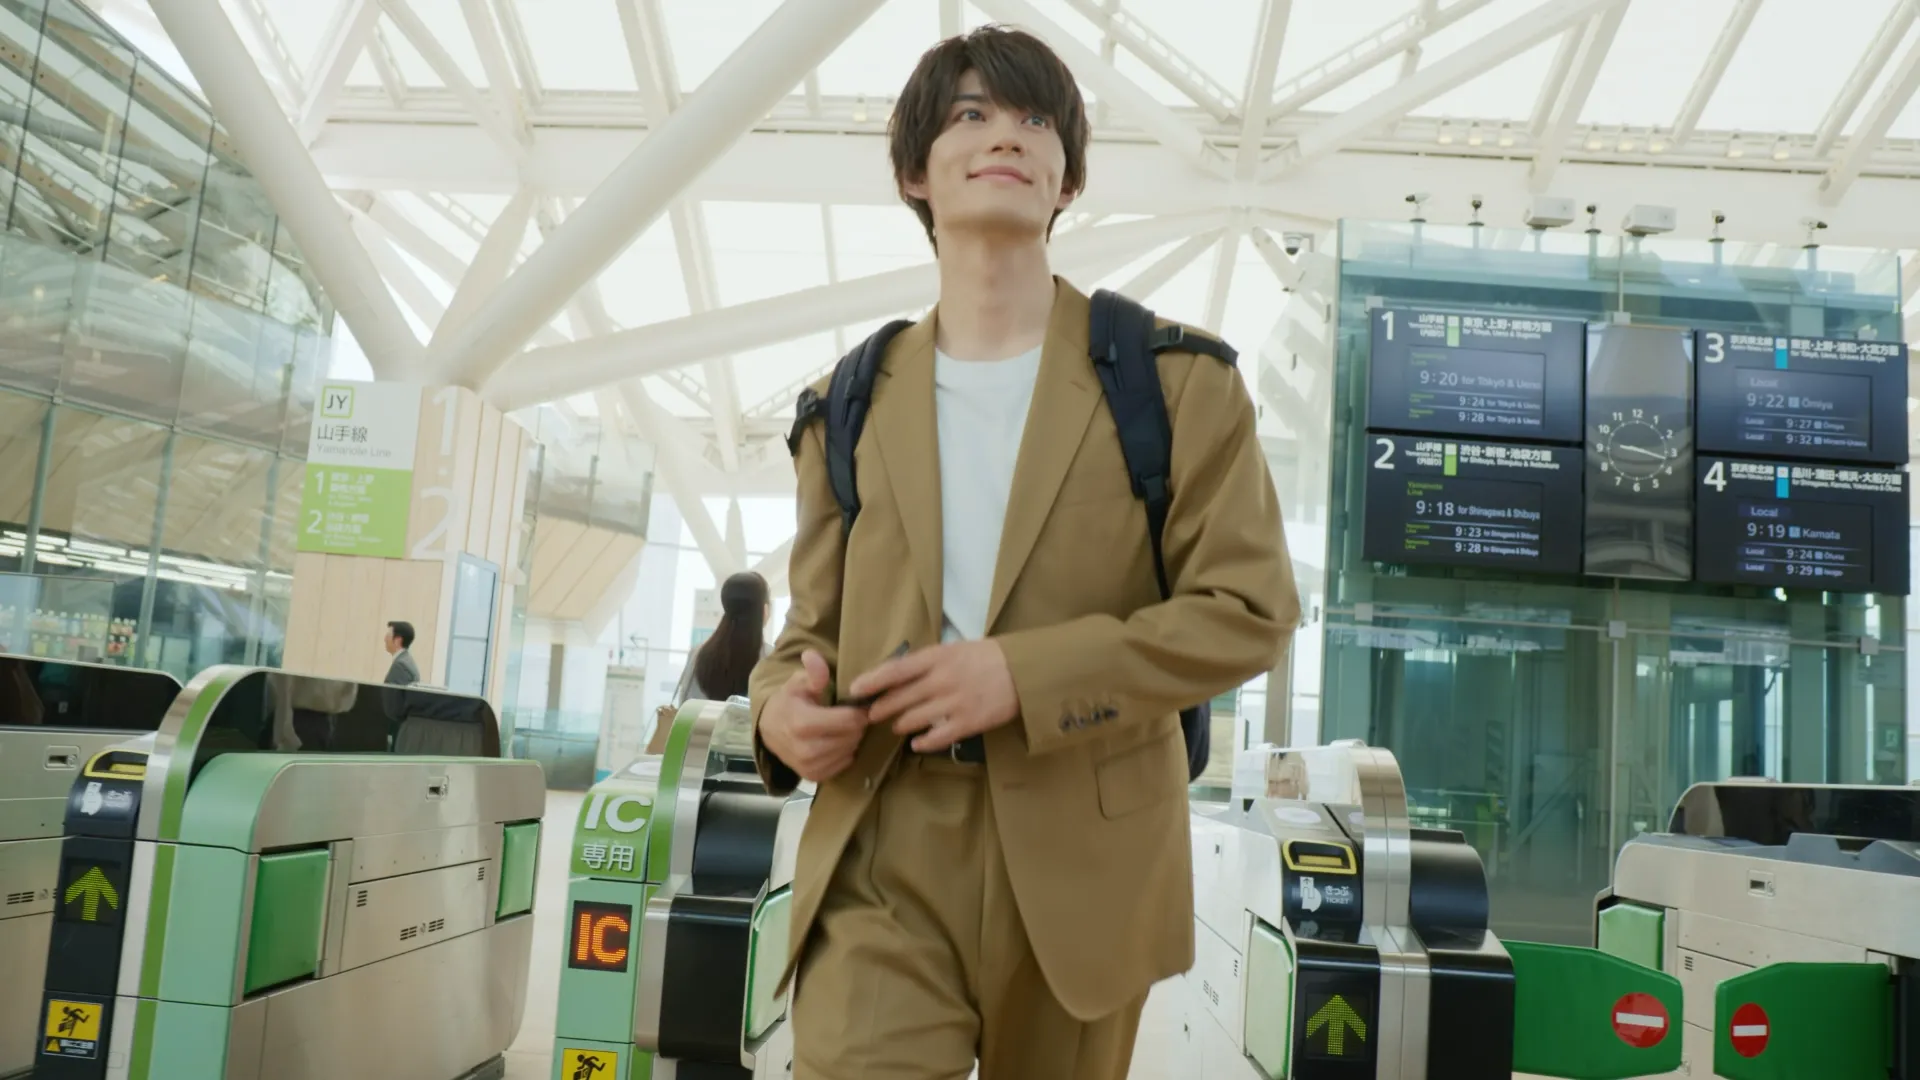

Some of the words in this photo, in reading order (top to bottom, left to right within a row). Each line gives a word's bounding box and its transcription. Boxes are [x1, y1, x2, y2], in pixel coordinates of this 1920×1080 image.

[1381, 311, 1394, 340] 1
[1704, 333, 1725, 363] 3
[1419, 370, 1458, 387] 9:20
[325, 394, 348, 410] JY
[1746, 393, 1784, 408] 9:22
[1612, 412, 1622, 421] 11
[1632, 409, 1643, 418] 12
[1653, 415, 1659, 425] 1
[317, 423, 368, 443] 山手線
[1598, 424, 1610, 434] 10
[1666, 429, 1674, 439] 2
[1374, 438, 1395, 469] 2
[1596, 443, 1604, 453] 9
[1671, 448, 1678, 458] 3
[1601, 462, 1608, 472] 8
[1665, 466, 1672, 475] 4
[1615, 476, 1622, 486] 7
[1703, 461, 1727, 492] 4
[314, 471, 324, 495] 1
[1633, 483, 1640, 493] 6
[1652, 479, 1659, 489] 5
[1416, 500, 1454, 516] 9:18
[1751, 507, 1778, 517] Local
[306, 509, 322, 534] 2
[1455, 526, 1481, 538] 9:23
[1747, 522, 1785, 538] 9:19
[1803, 528, 1840, 540] Kamata
[1455, 541, 1481, 554] 9:28
[1786, 548, 1812, 559] 9:24
[1786, 564, 1813, 576] 9:29
[584, 793, 651, 833] IC
[581, 842, 634, 872] 専用
[577, 913, 629, 963] IC
